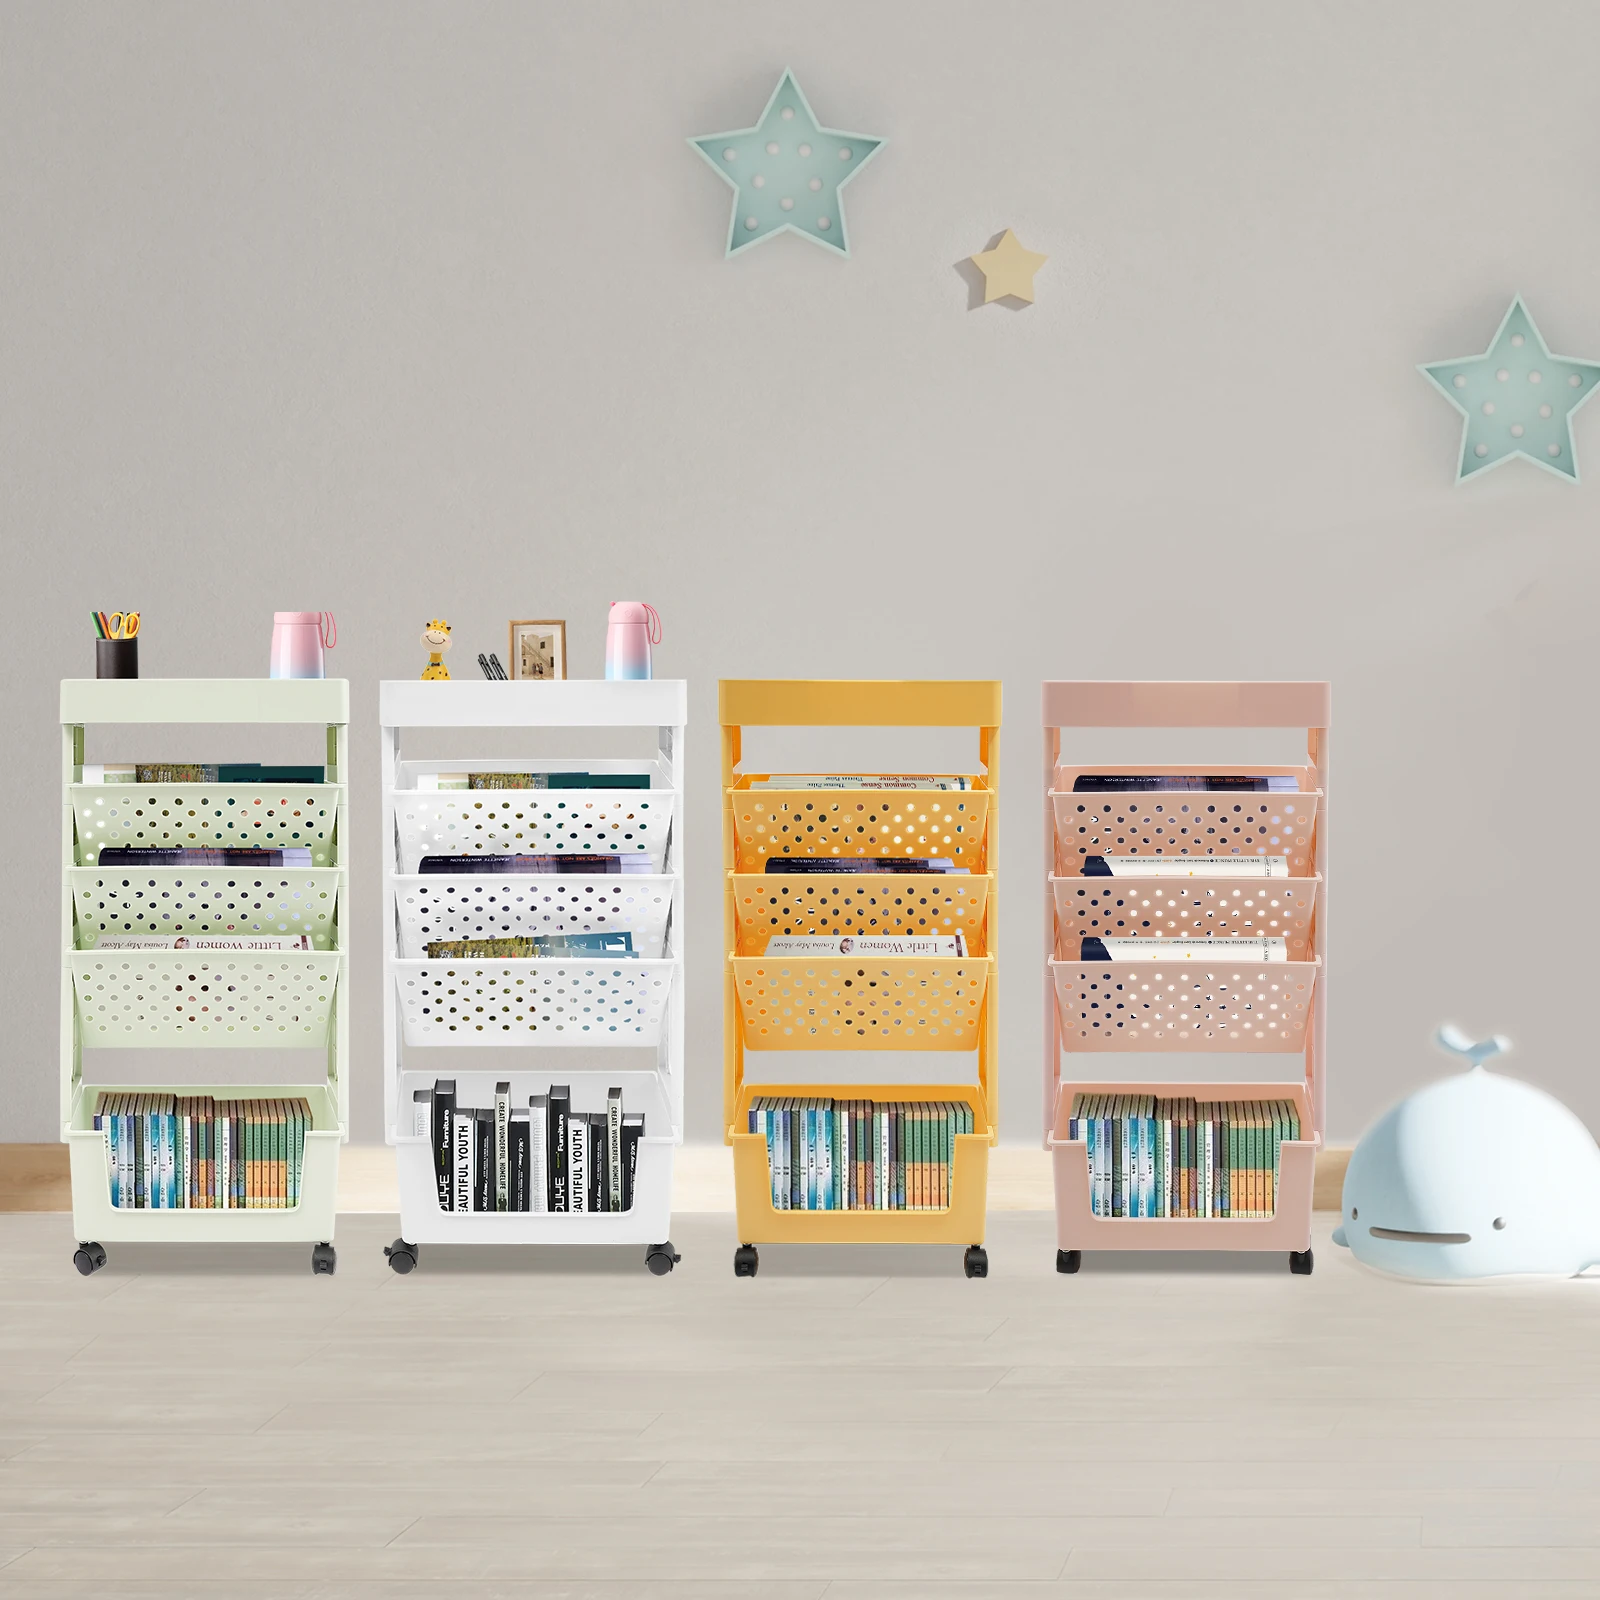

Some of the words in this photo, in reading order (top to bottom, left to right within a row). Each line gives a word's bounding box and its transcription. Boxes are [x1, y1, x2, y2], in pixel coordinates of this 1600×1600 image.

[859, 942, 904, 953] Women
[907, 942, 938, 953] Little
[442, 1109, 450, 1149] Furniture
[498, 1101, 506, 1123] CREATE
[610, 1106, 618, 1127] CREATE
[458, 1125, 468, 1161] YOUTH
[557, 1113, 565, 1152] Furniture
[572, 1129, 583, 1164] YOUTH
[611, 1128, 619, 1163] WONDERFUL
[499, 1162, 507, 1190] HOMELIFE
[572, 1167, 583, 1212] AUTIFUL
